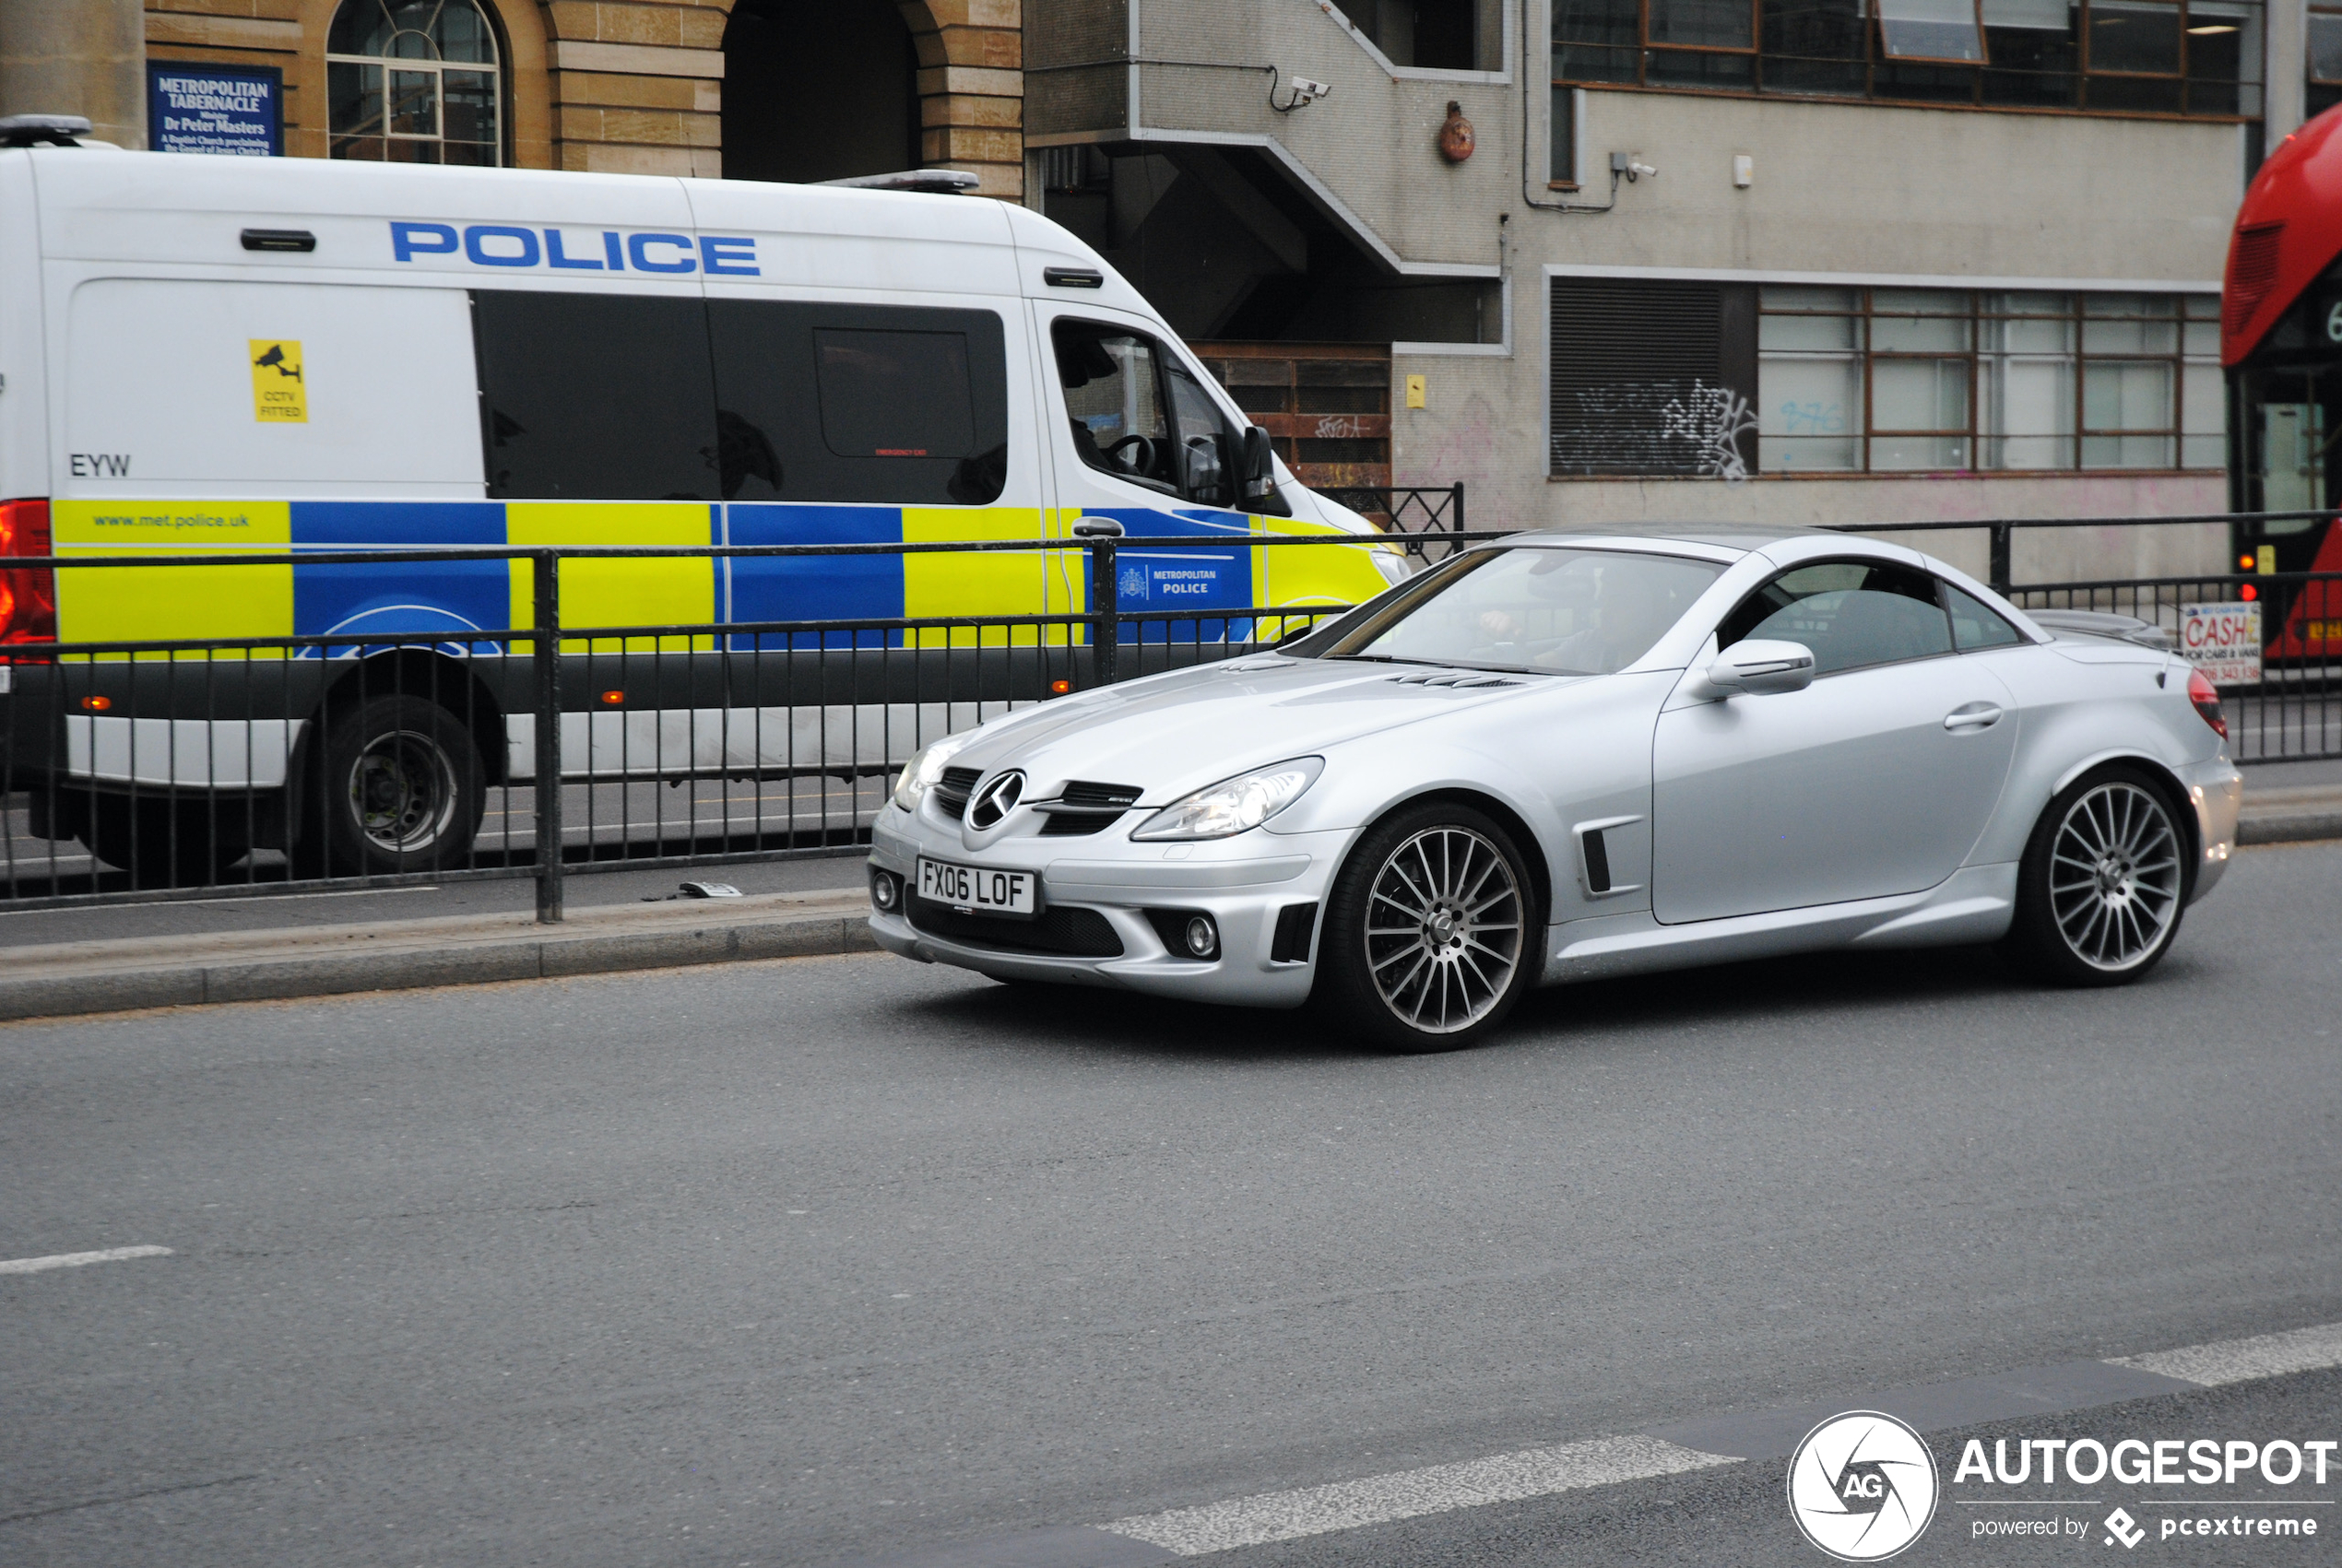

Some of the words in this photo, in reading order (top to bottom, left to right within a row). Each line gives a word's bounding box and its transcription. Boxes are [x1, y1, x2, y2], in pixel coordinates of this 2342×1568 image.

[159, 77, 268, 99] METROPOLITAN
[168, 93, 260, 112] TABERNACLE
[164, 116, 180, 131] Dr
[181, 116, 215, 133] Peter
[216, 119, 266, 136] Masters
[161, 134, 168, 143] A
[169, 134, 196, 146] Baptist
[196, 136, 224, 146] Church
[389, 221, 762, 277] POLICE
[264, 390, 295, 402] CCTV
[260, 406, 302, 418] FITTED
[69, 453, 131, 477] EYW
[93, 513, 249, 529] www.met.police.uk
[1153, 571, 1216, 580] METROPOLITAN
[1163, 583, 1209, 595] POLICE
[2185, 649, 2204, 660] FOR
[2205, 648, 2227, 659] CARS
[924, 861, 969, 901] FX06
[976, 870, 1024, 906] LOF
